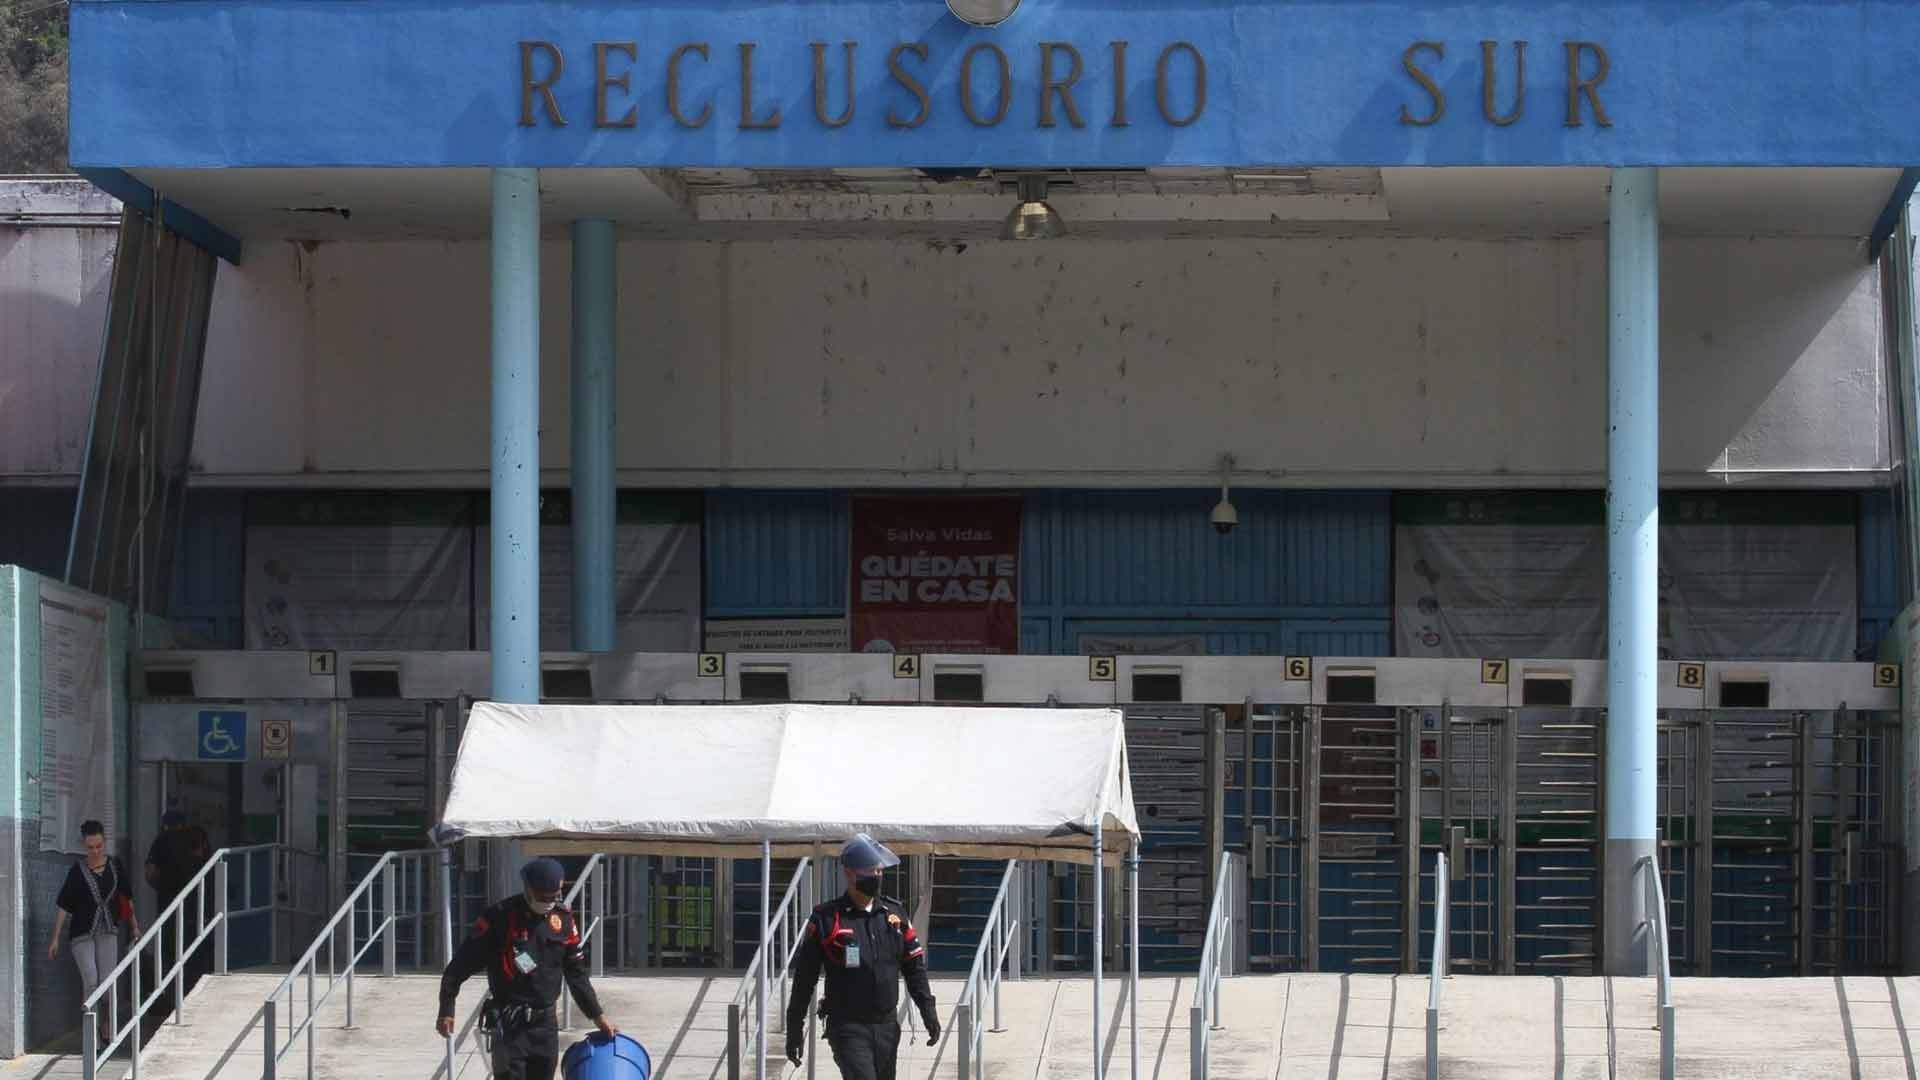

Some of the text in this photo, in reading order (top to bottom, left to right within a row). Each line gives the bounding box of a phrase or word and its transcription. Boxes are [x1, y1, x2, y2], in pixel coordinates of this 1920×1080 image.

[518, 40, 1613, 128] RECLUSORIO SUR
[887, 528, 992, 541] Salva Vidas
[861, 550, 1015, 577] QUÉDATE
[862, 579, 1015, 602] EN CASA
[316, 654, 327, 672] 1
[704, 656, 718, 674] 3
[899, 657, 914, 674] 4
[1095, 660, 1110, 677] 5
[1290, 661, 1304, 677] 6
[1488, 663, 1501, 680] 7
[1684, 667, 1698, 684] 8
[1880, 667, 1894, 684] 9
